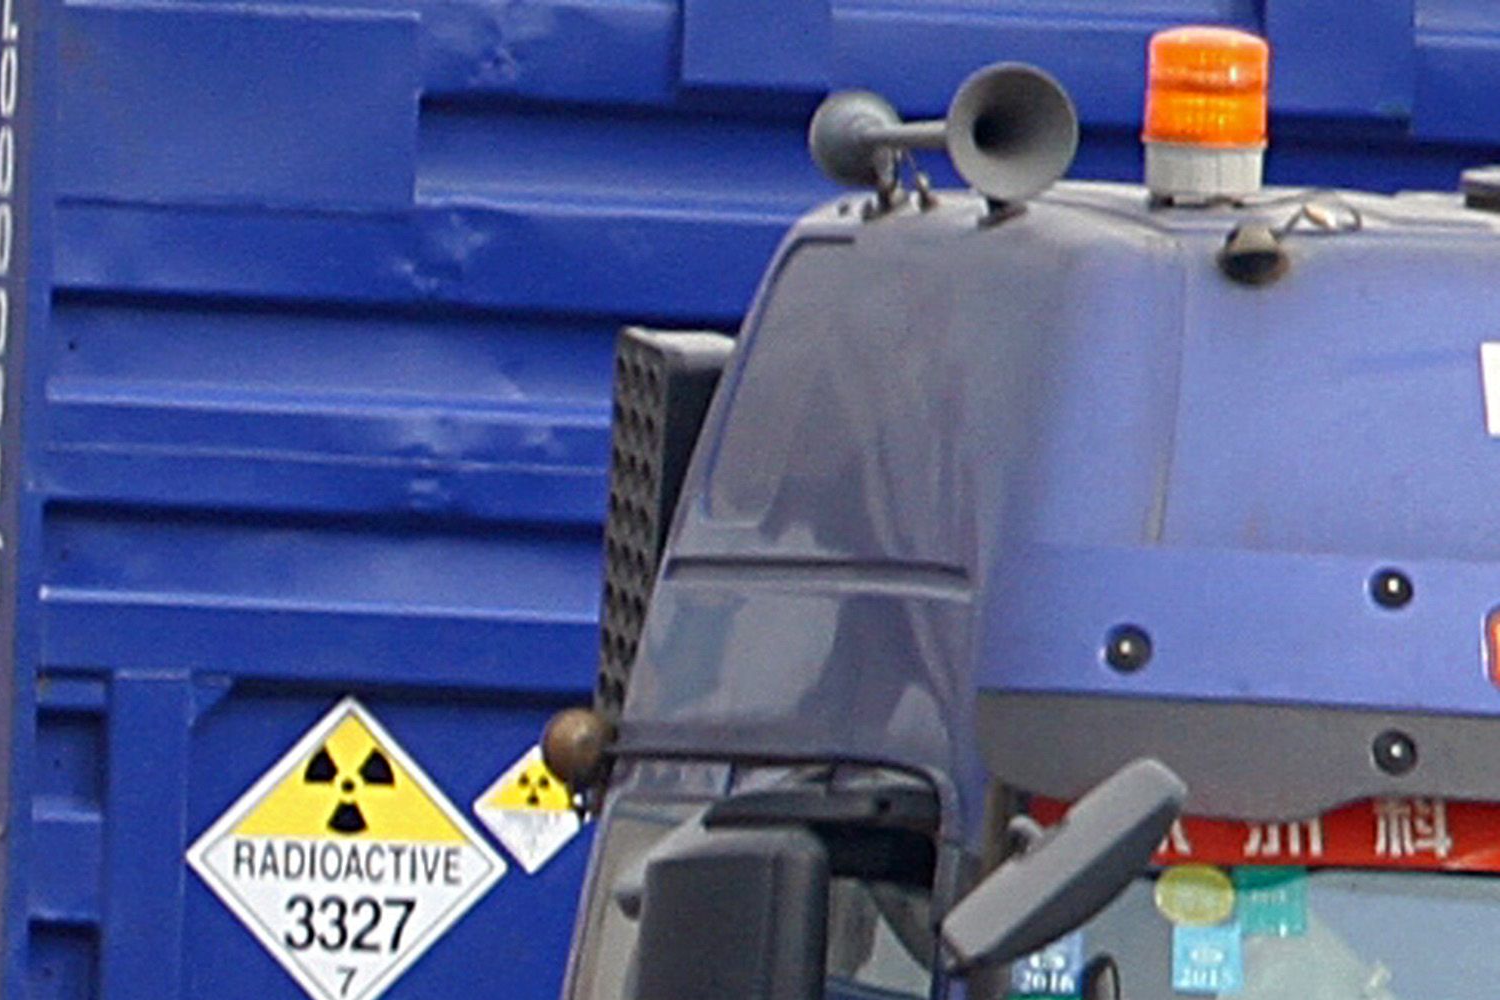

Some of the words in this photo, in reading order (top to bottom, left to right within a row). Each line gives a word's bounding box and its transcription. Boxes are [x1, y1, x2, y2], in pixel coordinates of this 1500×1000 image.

[233, 840, 462, 886] RADIOACTIVE
[283, 894, 417, 953] 3327
[338, 967, 358, 998] 7
